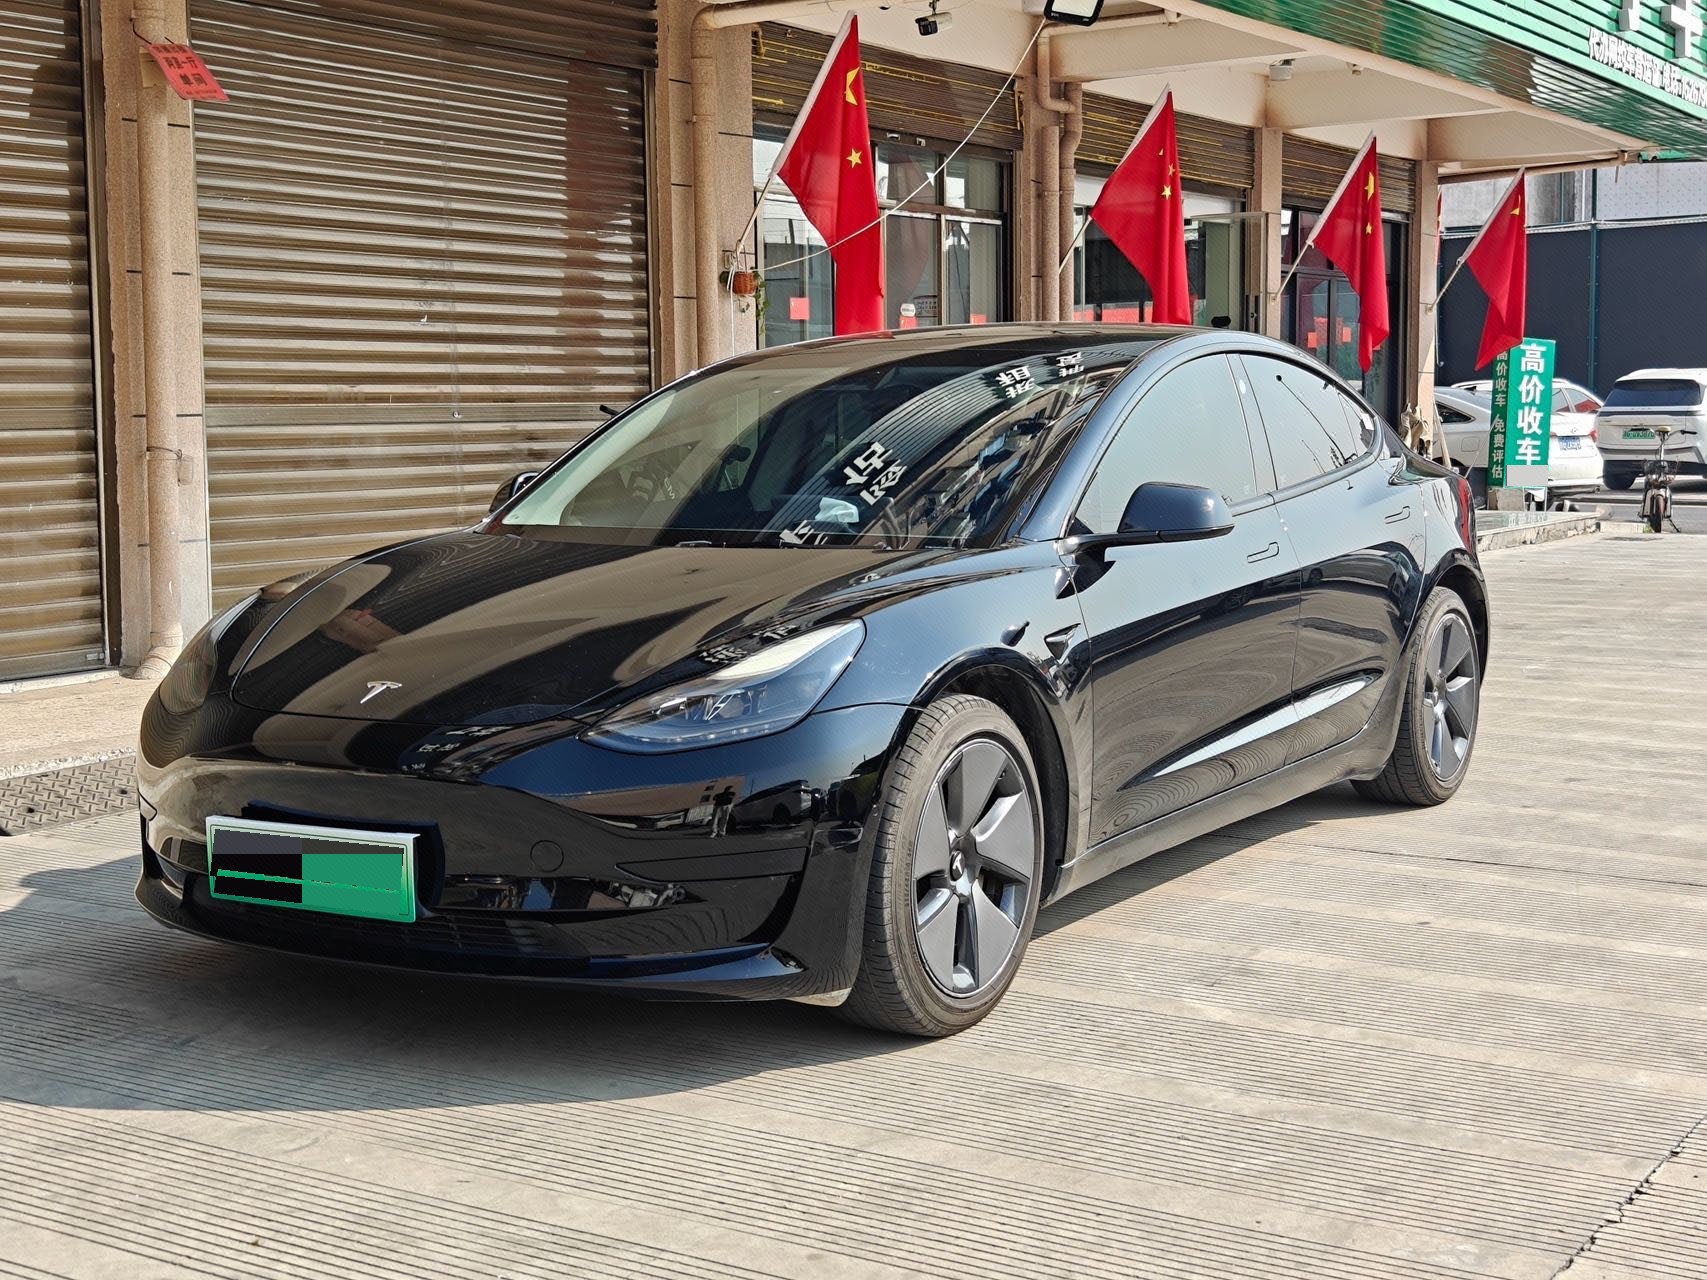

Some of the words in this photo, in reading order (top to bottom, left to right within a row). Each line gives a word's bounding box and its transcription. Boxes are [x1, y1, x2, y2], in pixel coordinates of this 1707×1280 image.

[1494, 351, 1508, 407] 高价收车
[1515, 343, 1546, 465] 高价收车
[1491, 414, 1506, 479] 免费评估
